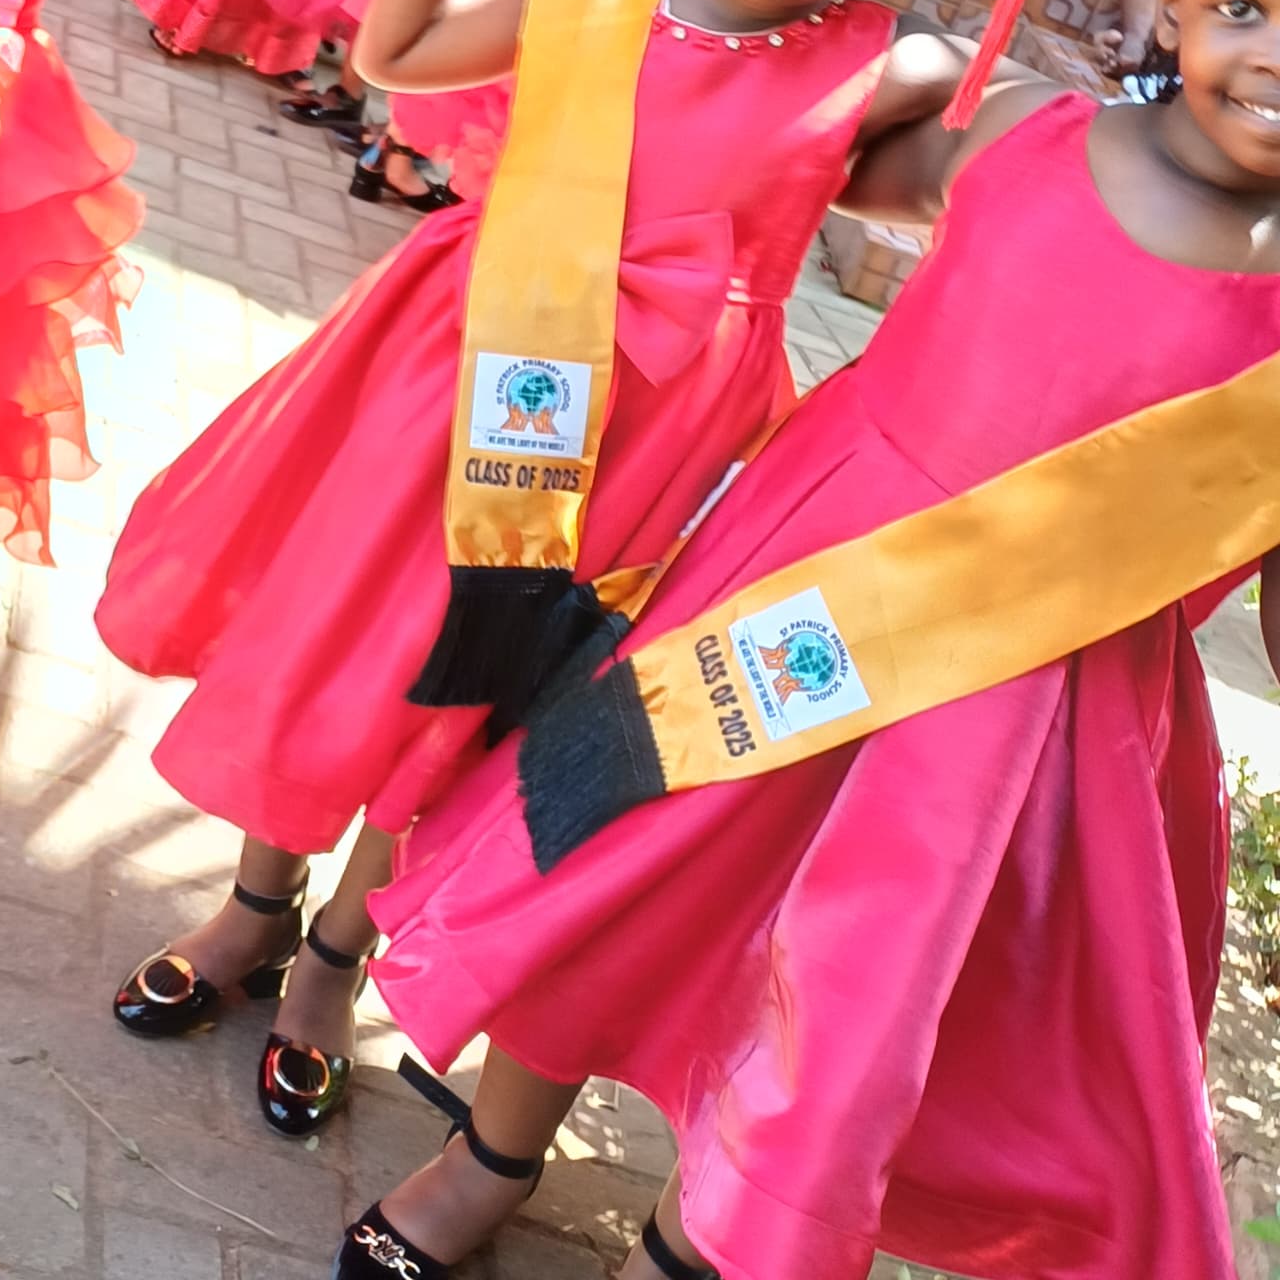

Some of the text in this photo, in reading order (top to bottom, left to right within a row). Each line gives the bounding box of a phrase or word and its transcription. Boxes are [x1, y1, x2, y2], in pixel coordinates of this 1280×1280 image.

[465, 458, 582, 491] CLASS OF 2025
[790, 620, 829, 634] PATRICK
[830, 633, 848, 678] PRIMARY
[694, 634, 757, 757] CLASS OF 2025
[807, 680, 842, 702] SCHOOL
